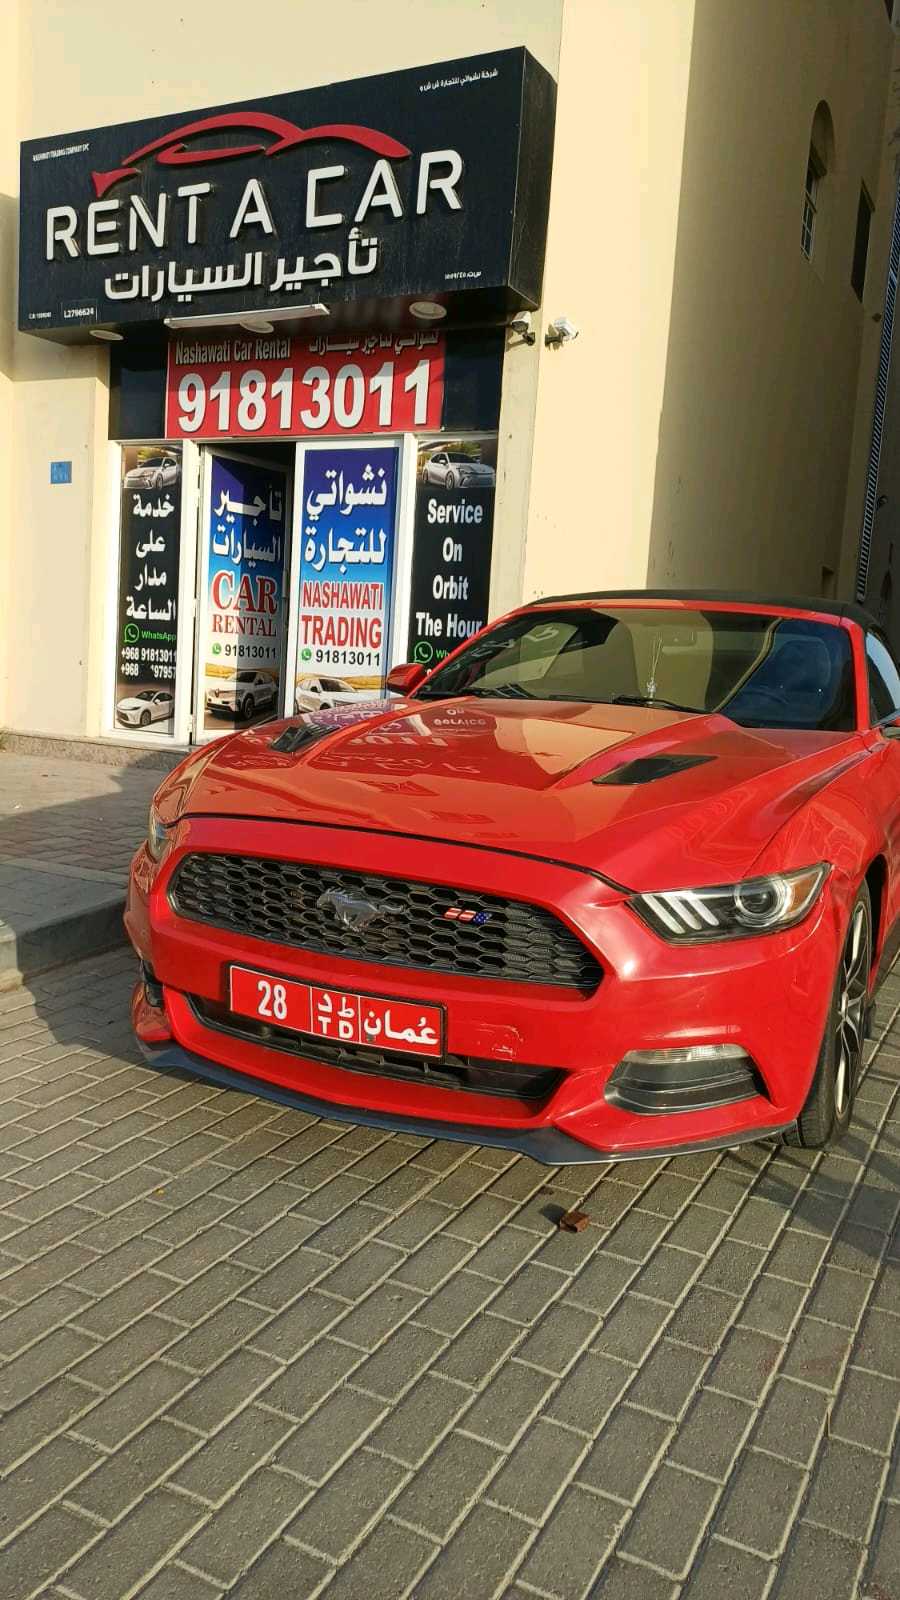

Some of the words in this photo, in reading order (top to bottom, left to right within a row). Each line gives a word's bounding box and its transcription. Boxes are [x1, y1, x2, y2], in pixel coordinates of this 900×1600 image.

[46, 182, 211, 260] RENT
[229, 179, 273, 238] A
[306, 149, 463, 228] CAR
[270, 227, 378, 291] تأجير
[105, 251, 262, 301] السيارات
[175, 340, 231, 364] Nashawati
[234, 340, 253, 361] Car
[255, 338, 291, 360] Rental
[178, 359, 430, 432] 91813011
[133, 494, 174, 517] خدمة
[306, 464, 387, 520] نشواتي
[428, 498, 483, 524] Service
[136, 529, 165, 558] على
[213, 524, 281, 568] السيارات
[305, 526, 387, 574] للتجارة
[442, 537, 462, 562] On
[134, 563, 167, 591] مدار
[432, 575, 469, 600] Orbit
[212, 571, 277, 615] CAR
[302, 582, 384, 610] NASHAWATI
[126, 596, 176, 620] الساعة
[141, 630, 176, 642] WhatsApp
[212, 614, 277, 637] RENTAL
[301, 615, 382, 648] TRADING
[416, 612, 442, 637] The
[446, 613, 482, 637] Hour
[121, 646, 139, 660] +968
[141, 647, 177, 663] 91813011
[225, 644, 276, 659] 91813011
[315, 650, 380, 666] 91813011
[121, 662, 139, 676] +968
[257, 980, 287, 1020] 28
